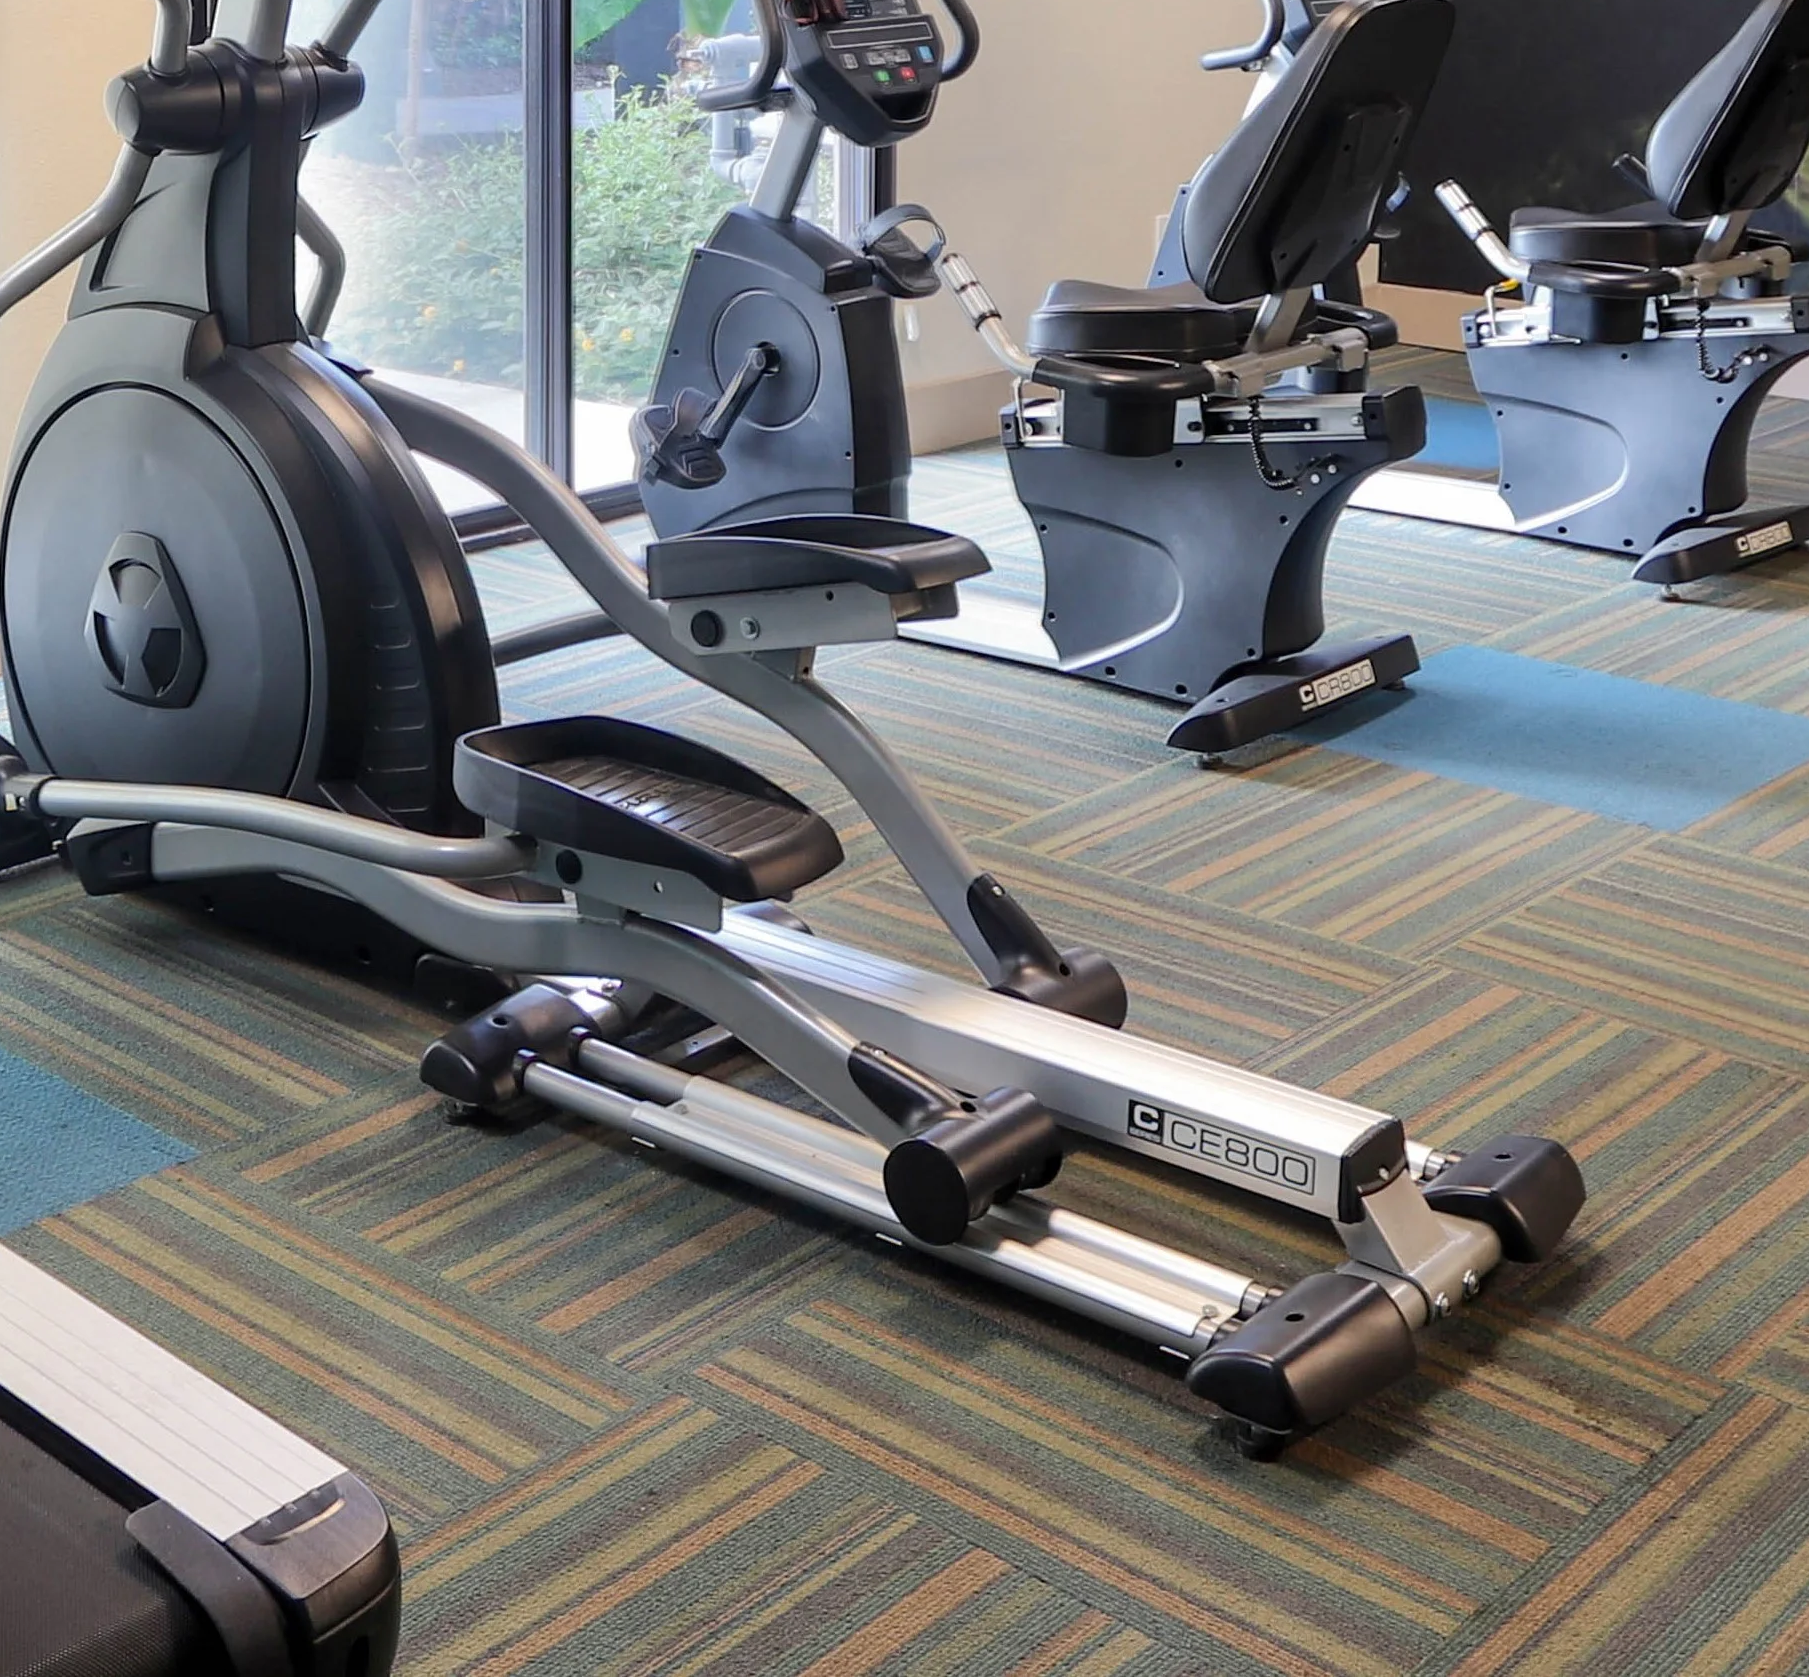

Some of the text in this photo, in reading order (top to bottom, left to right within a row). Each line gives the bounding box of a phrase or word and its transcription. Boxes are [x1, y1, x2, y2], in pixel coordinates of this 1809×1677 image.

[1299, 664, 1372, 704] C CR800
[1133, 1104, 1309, 1186] C CE800
